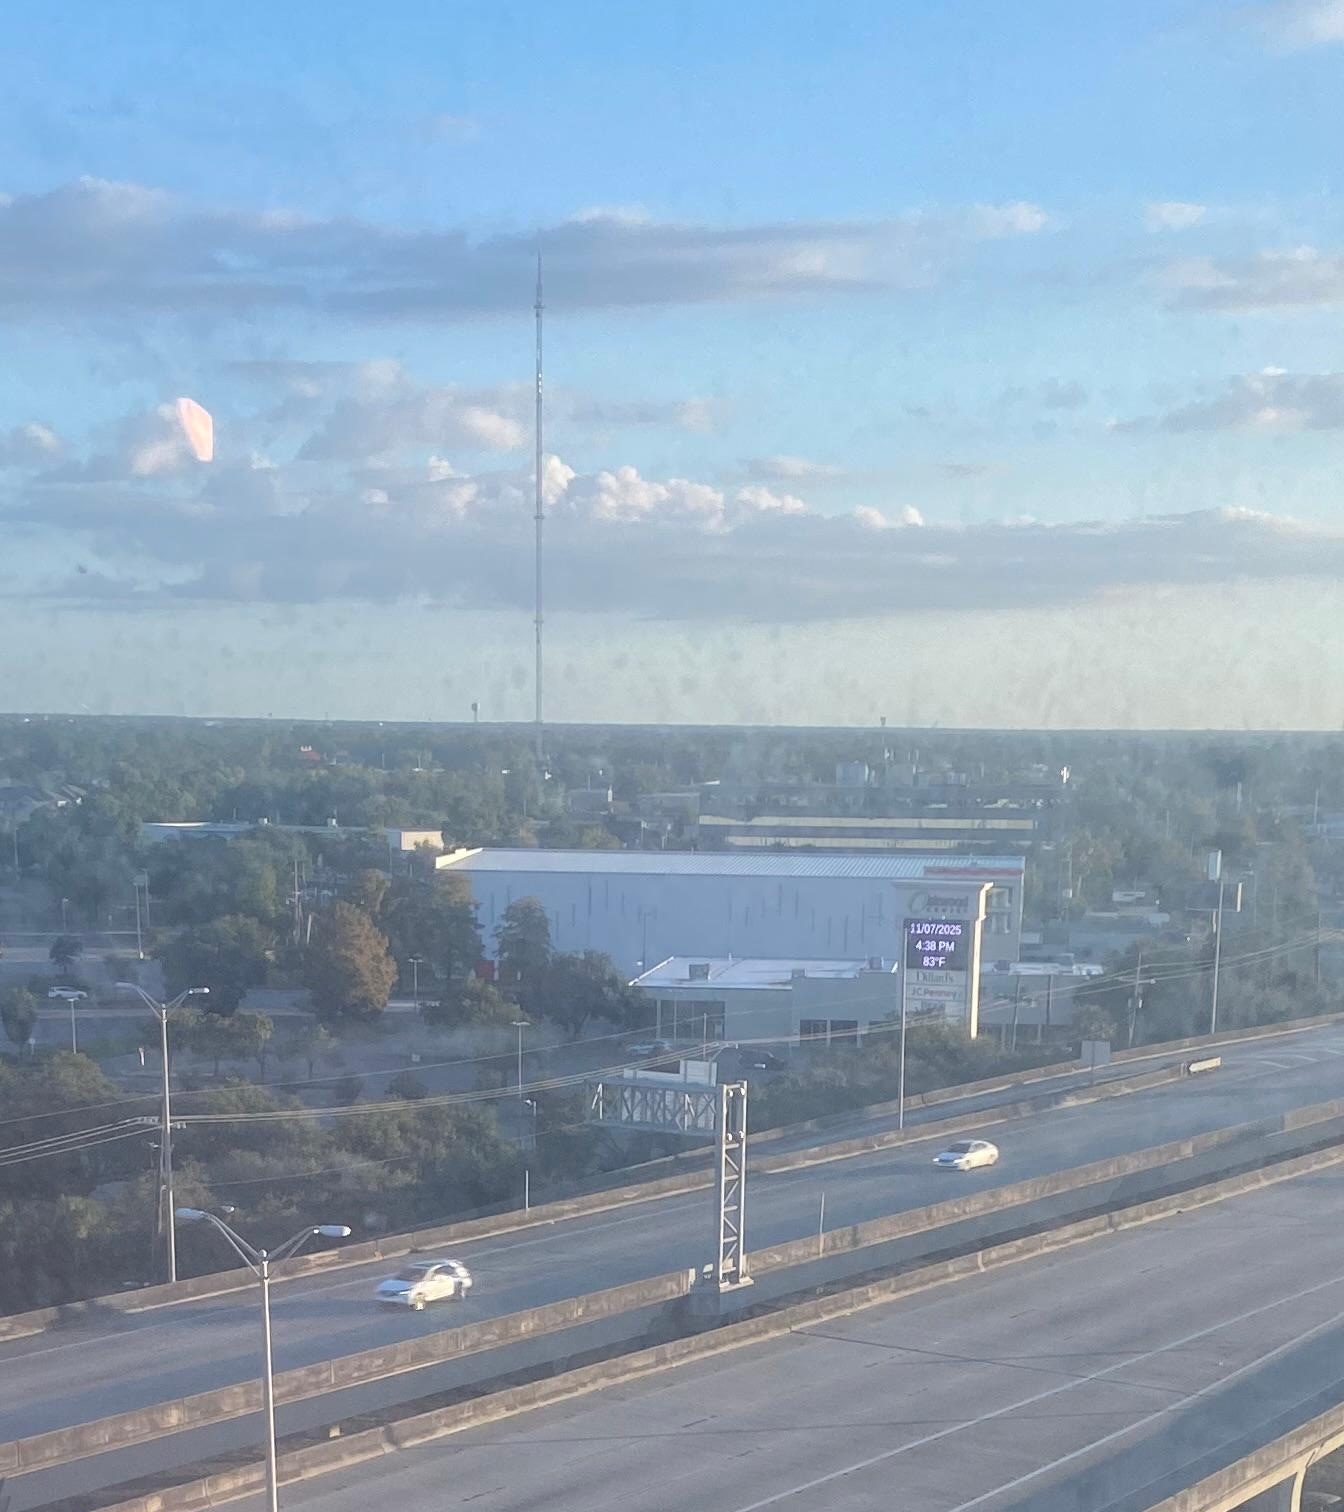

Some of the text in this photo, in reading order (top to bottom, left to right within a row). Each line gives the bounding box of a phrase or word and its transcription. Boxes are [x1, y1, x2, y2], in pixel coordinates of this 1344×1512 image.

[910, 923, 962, 936] 11/07/2025
[915, 940, 956, 953] 4:38 PM
[922, 956, 947, 967] 83°F
